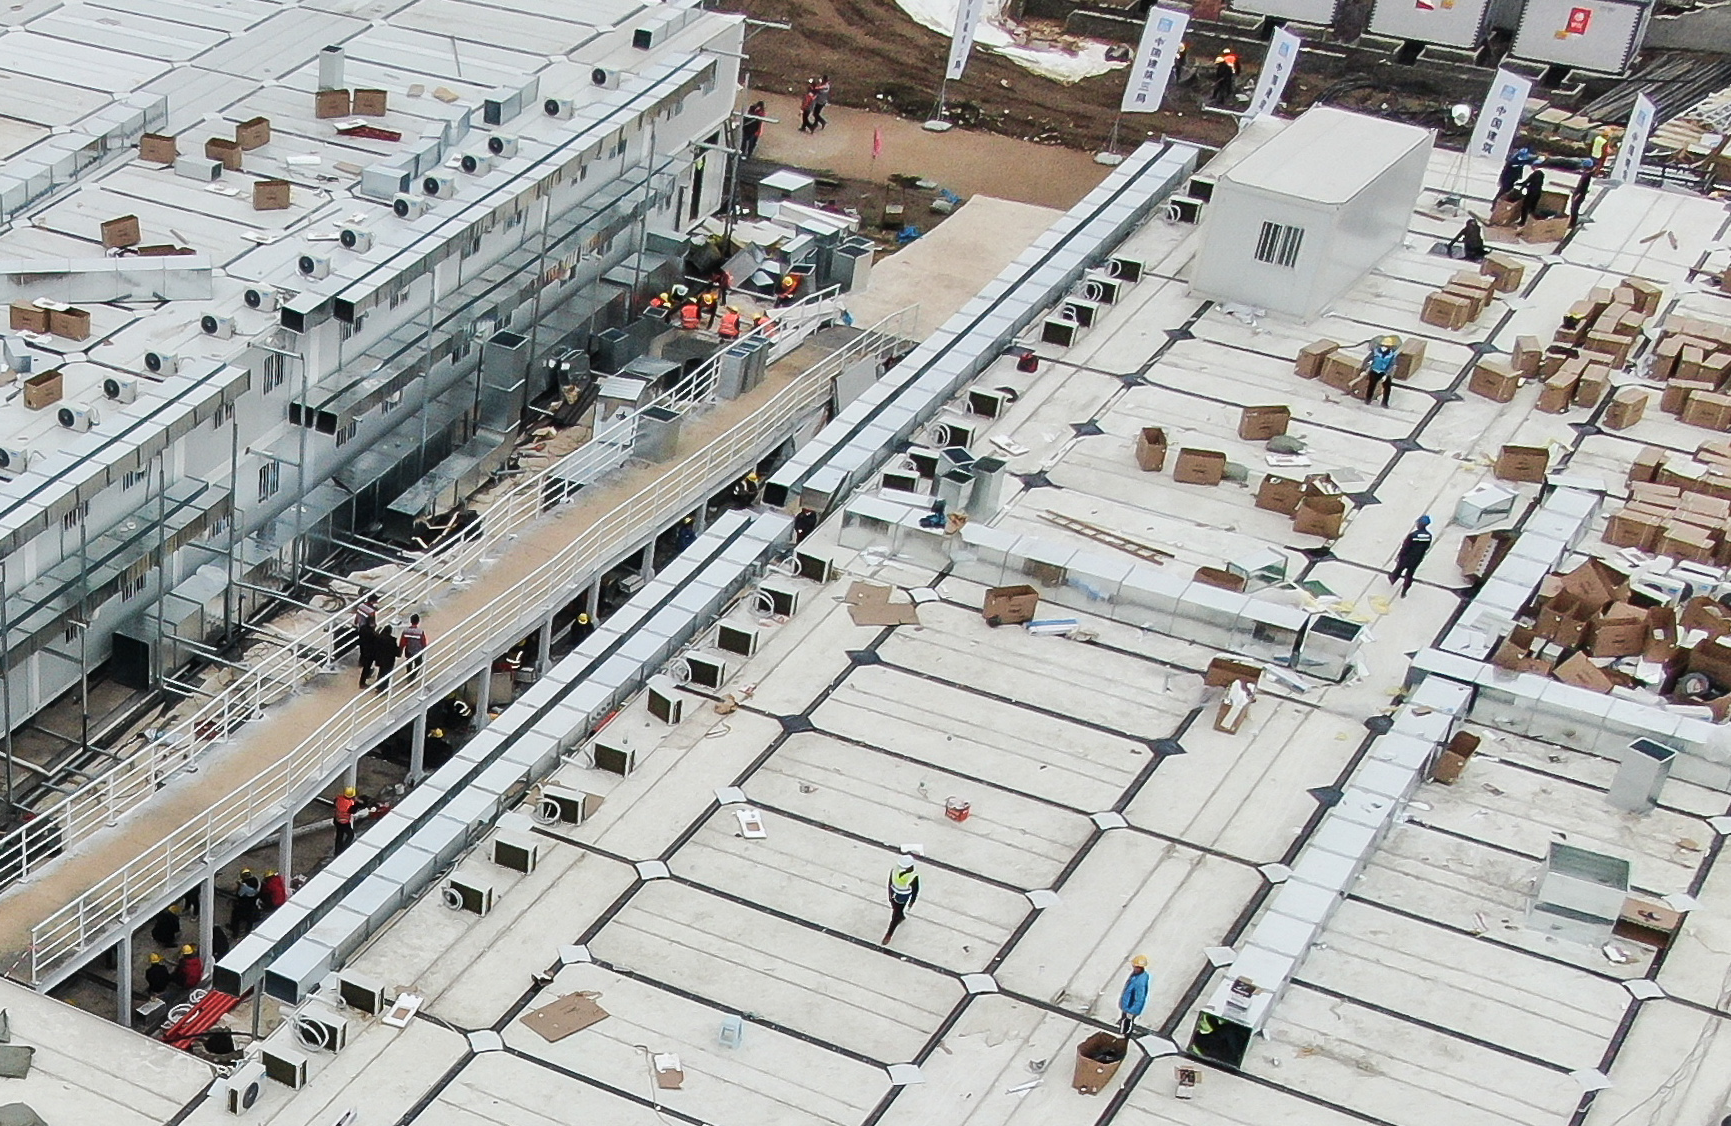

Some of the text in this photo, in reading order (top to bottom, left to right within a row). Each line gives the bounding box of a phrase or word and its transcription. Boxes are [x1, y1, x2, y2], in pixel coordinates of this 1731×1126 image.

[1134, 36, 1167, 104] 中国建筑三局
[1477, 105, 1507, 158] 中国建筑
